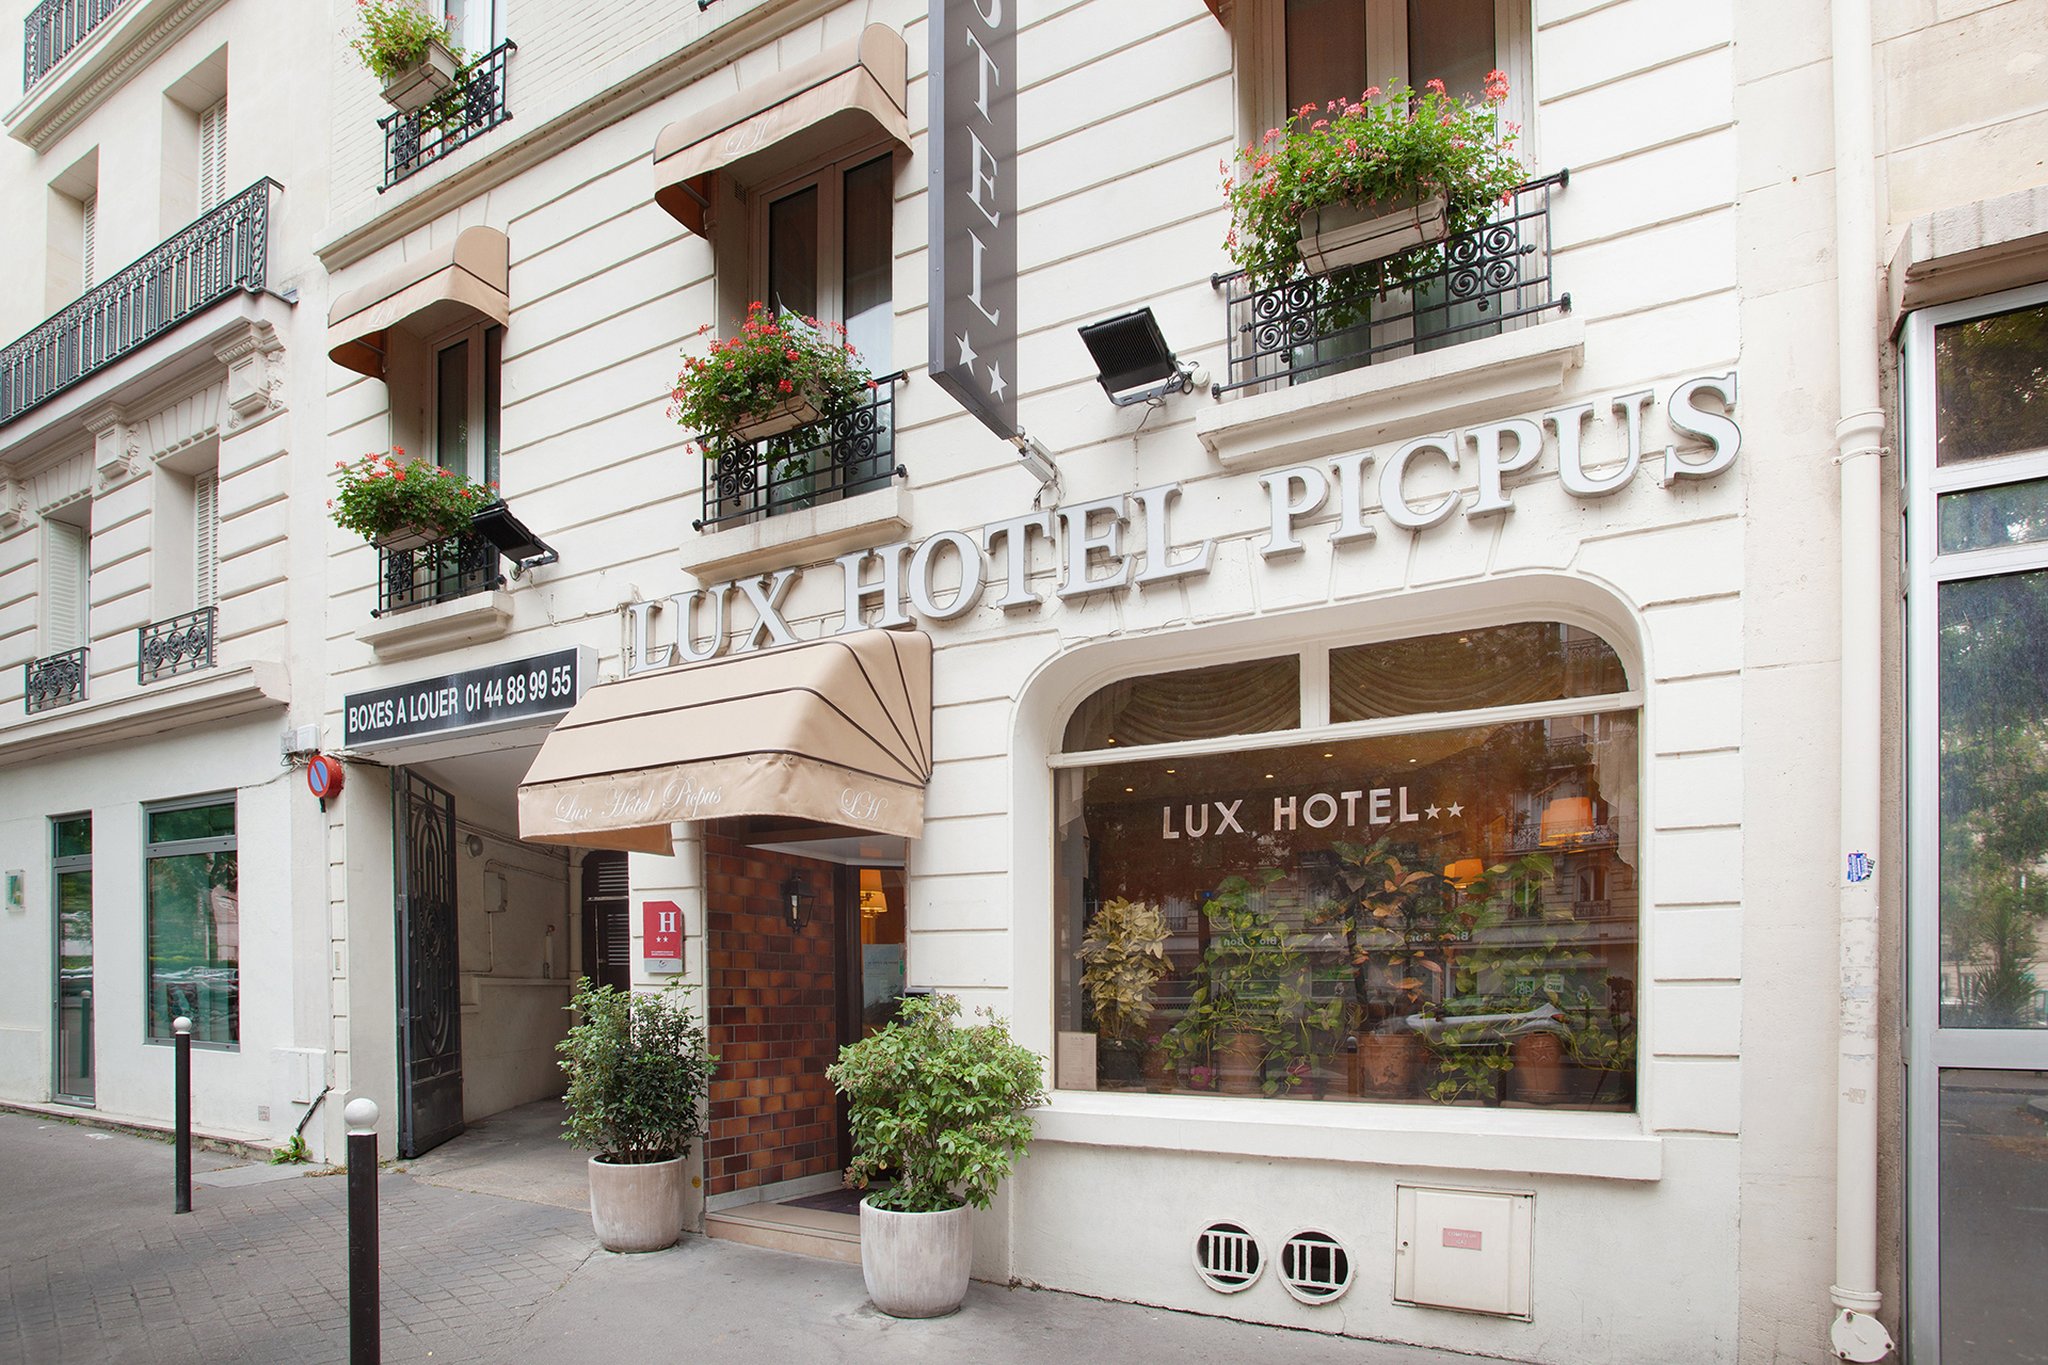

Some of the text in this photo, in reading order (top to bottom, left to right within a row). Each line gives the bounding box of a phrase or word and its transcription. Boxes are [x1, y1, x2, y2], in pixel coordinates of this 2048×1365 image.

[628, 371, 1743, 676] LUX HOTEL PICPUS
[349, 699, 393, 733] BOXES
[396, 697, 407, 725] A
[410, 687, 458, 722] LOUER
[507, 674, 525, 705] 88
[529, 669, 547, 701] 99
[551, 665, 571, 697] 55
[552, 793, 593, 823] Lux
[662, 776, 721, 817] Picpus
[840, 788, 889, 822] LH
[1163, 786, 1419, 839] LUX HOTEL
[658, 911, 677, 933] H
